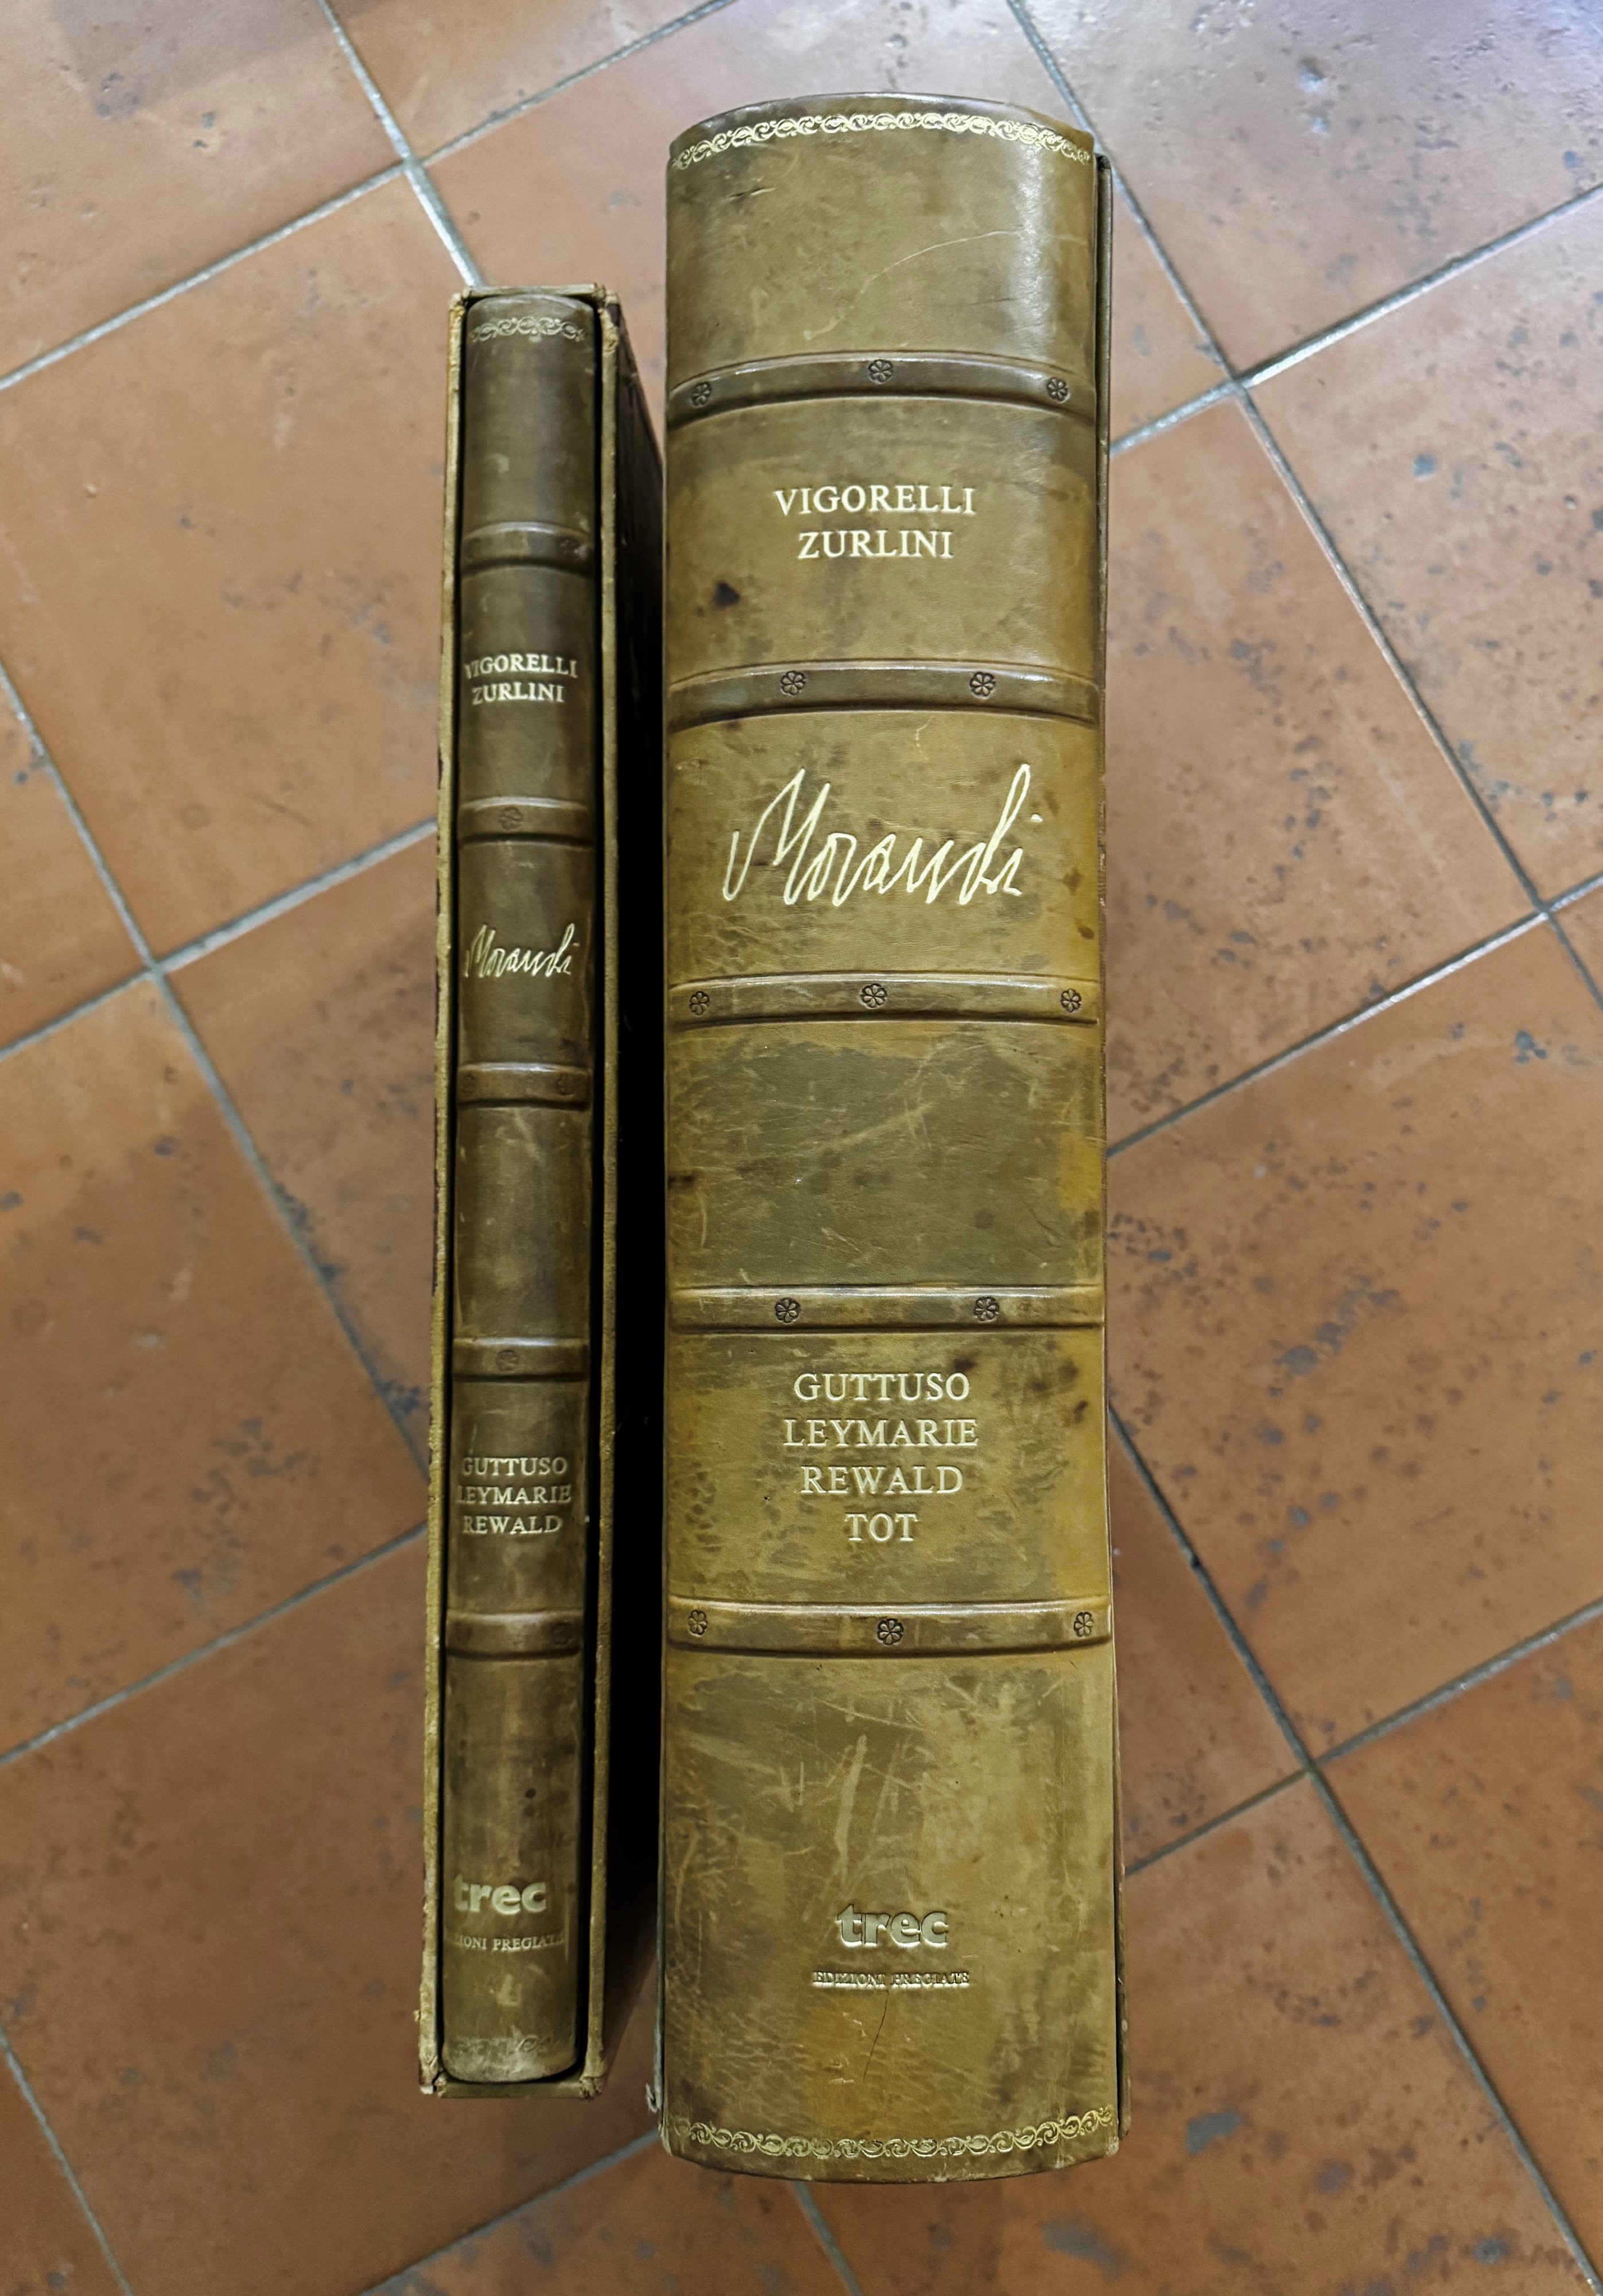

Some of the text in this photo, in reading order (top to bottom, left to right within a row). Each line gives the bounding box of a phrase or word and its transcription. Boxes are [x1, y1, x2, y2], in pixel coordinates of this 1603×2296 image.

[774, 484, 976, 515] VIGORELLI
[798, 530, 953, 559] ZURLINI
[464, 653, 577, 678] VIGORELLI
[472, 681, 564, 705] ZURLINI
[794, 1372, 970, 1401] GUTTUSO
[783, 1419, 979, 1447] LEYMARIE
[463, 1457, 568, 1476] GUTTUSO
[800, 1465, 963, 1494] REWALD
[457, 1484, 572, 1505] LEYMARIE
[462, 1515, 562, 1534] REWALD
[844, 1513, 919, 1542] TOT
[455, 1874, 546, 1915] trec
[835, 1903, 949, 1947] trec
